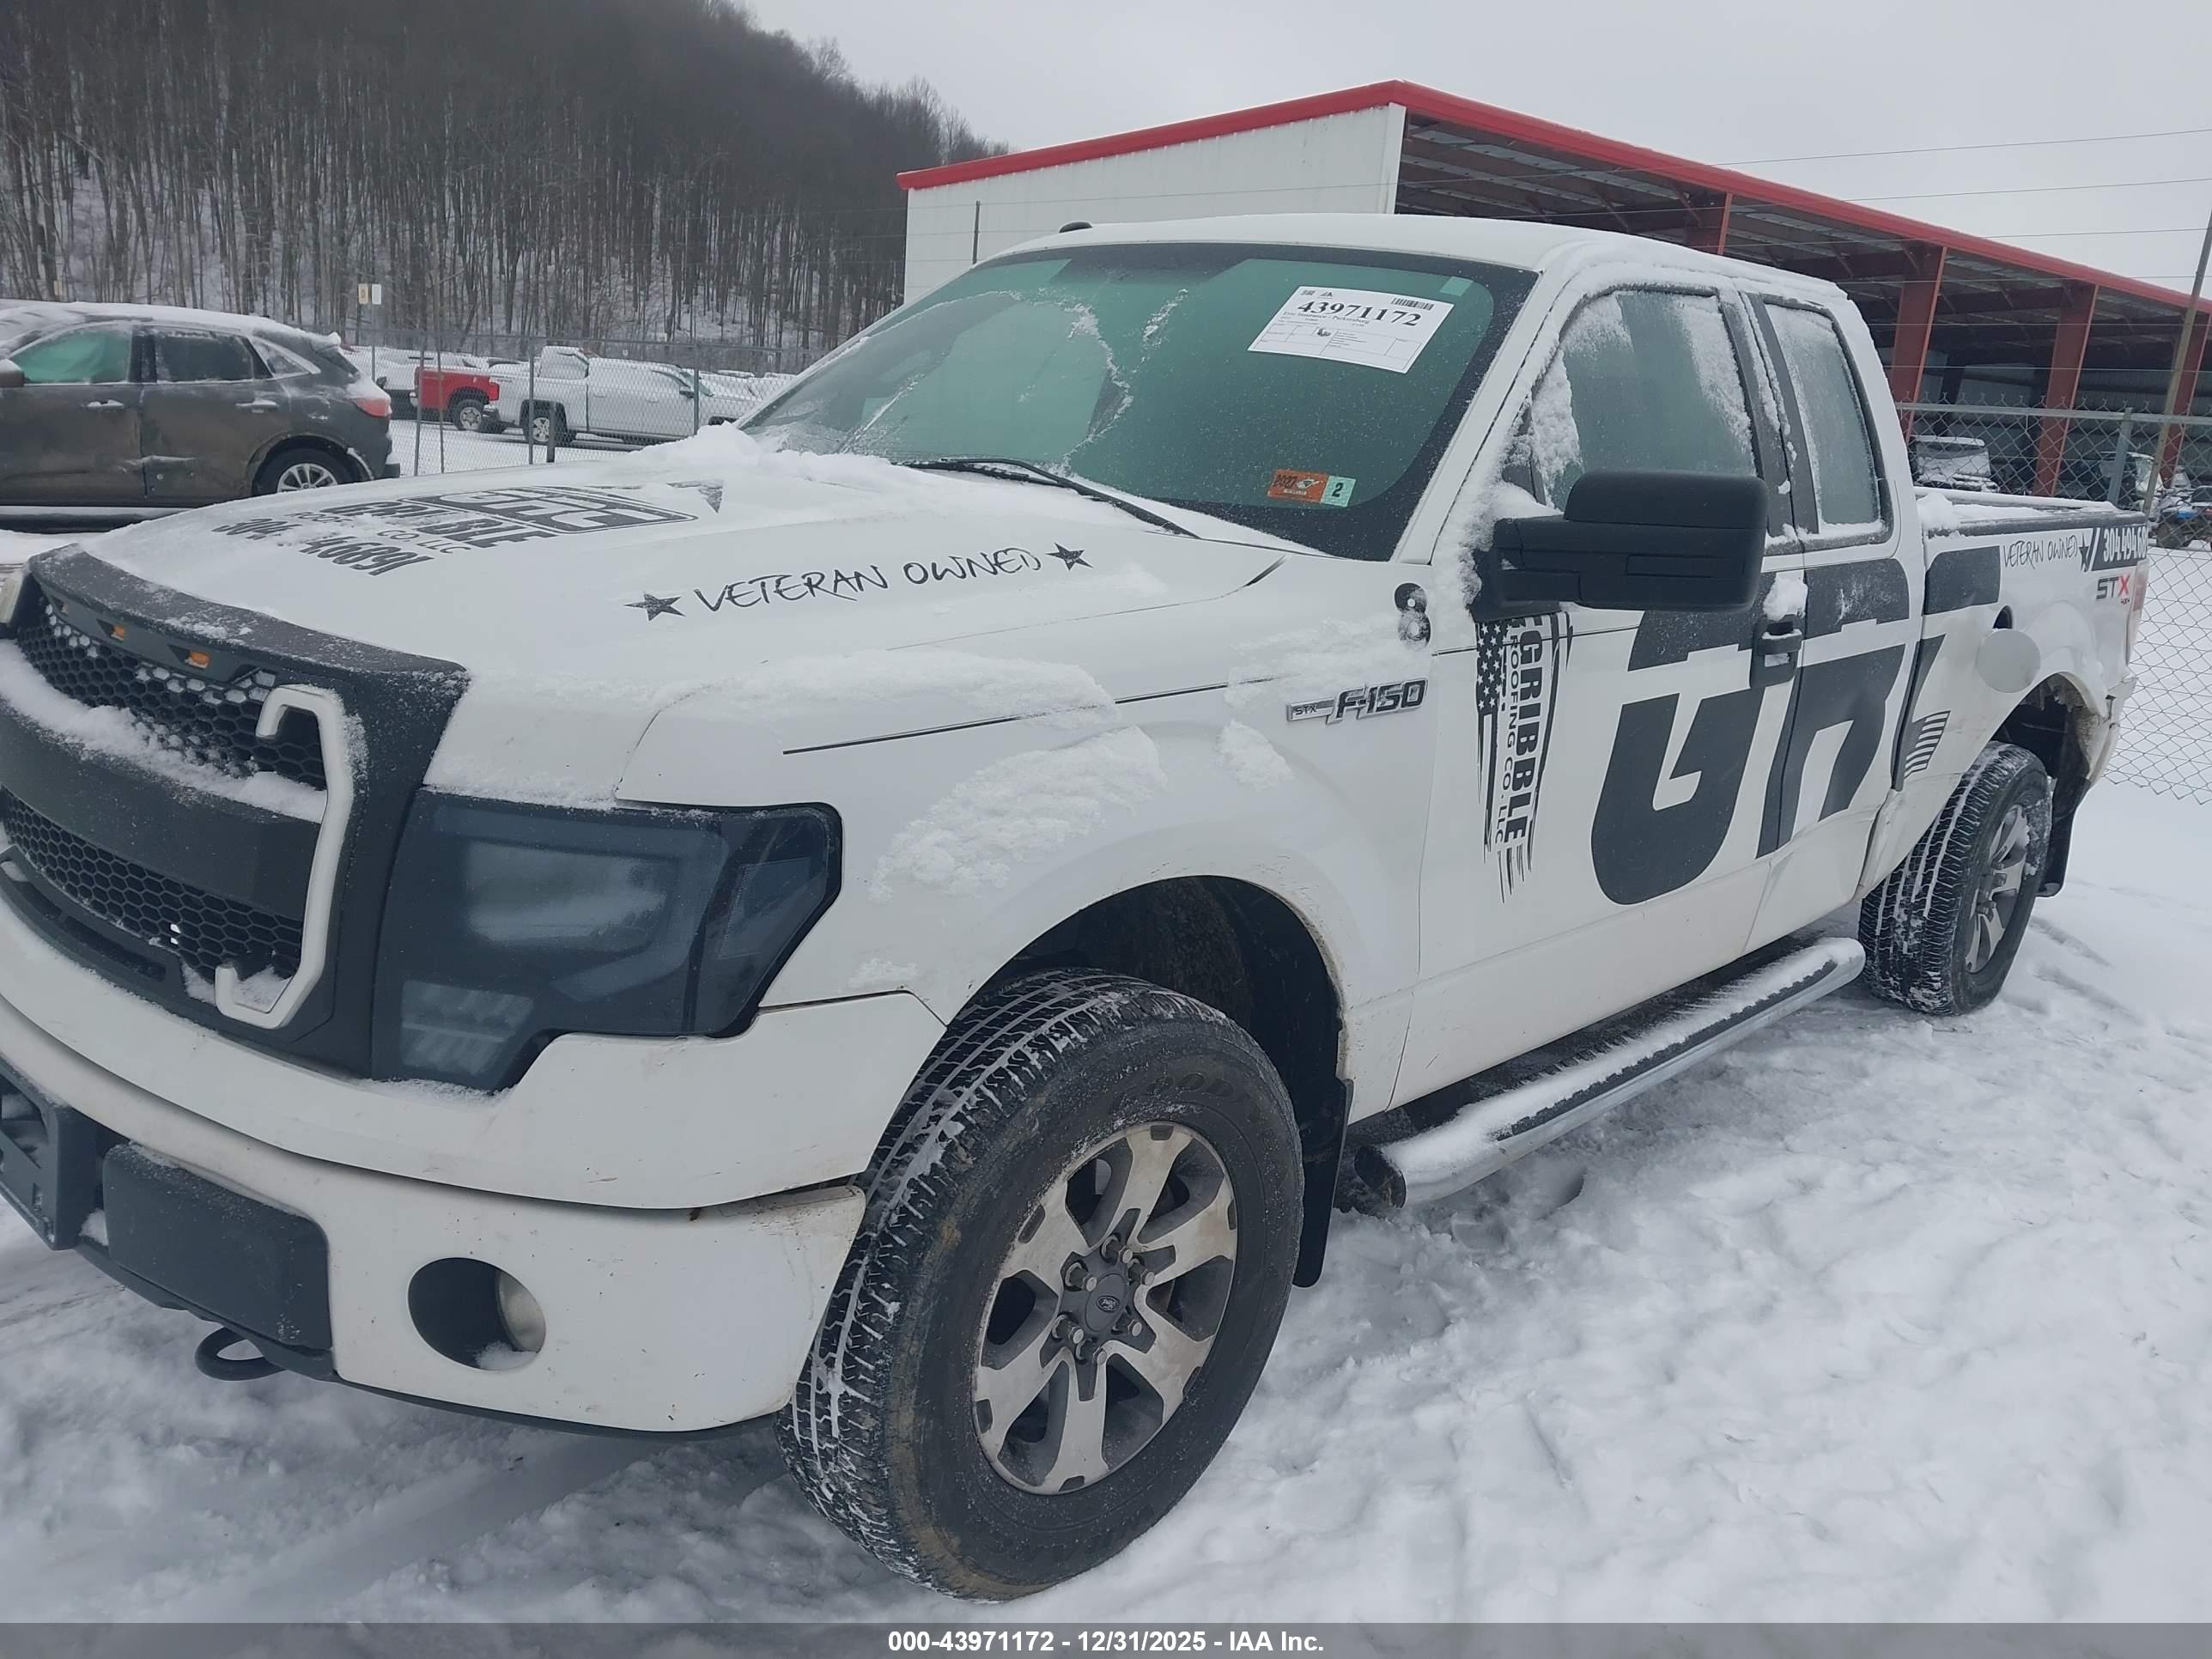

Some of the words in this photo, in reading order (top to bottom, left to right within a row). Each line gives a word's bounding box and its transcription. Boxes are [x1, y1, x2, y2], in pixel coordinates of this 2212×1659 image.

[1297, 301, 1422, 326] 43971172
[1332, 483, 1344, 497] 2
[319, 501, 560, 549] GRIBLE
[416, 539, 471, 554] LLC
[2002, 540, 2045, 570] VETERAN
[2047, 534, 2078, 561] OWNED
[693, 564, 890, 612] VETERAN
[902, 547, 1042, 585] OWNED
[2096, 574, 2130, 599] STX
[1295, 705, 1318, 715] STX
[1335, 678, 1427, 719] F-150
[1506, 635, 1518, 748] ROOFING
[1504, 629, 1543, 844] GRIBBLE
[1494, 804, 1507, 844] LLC
